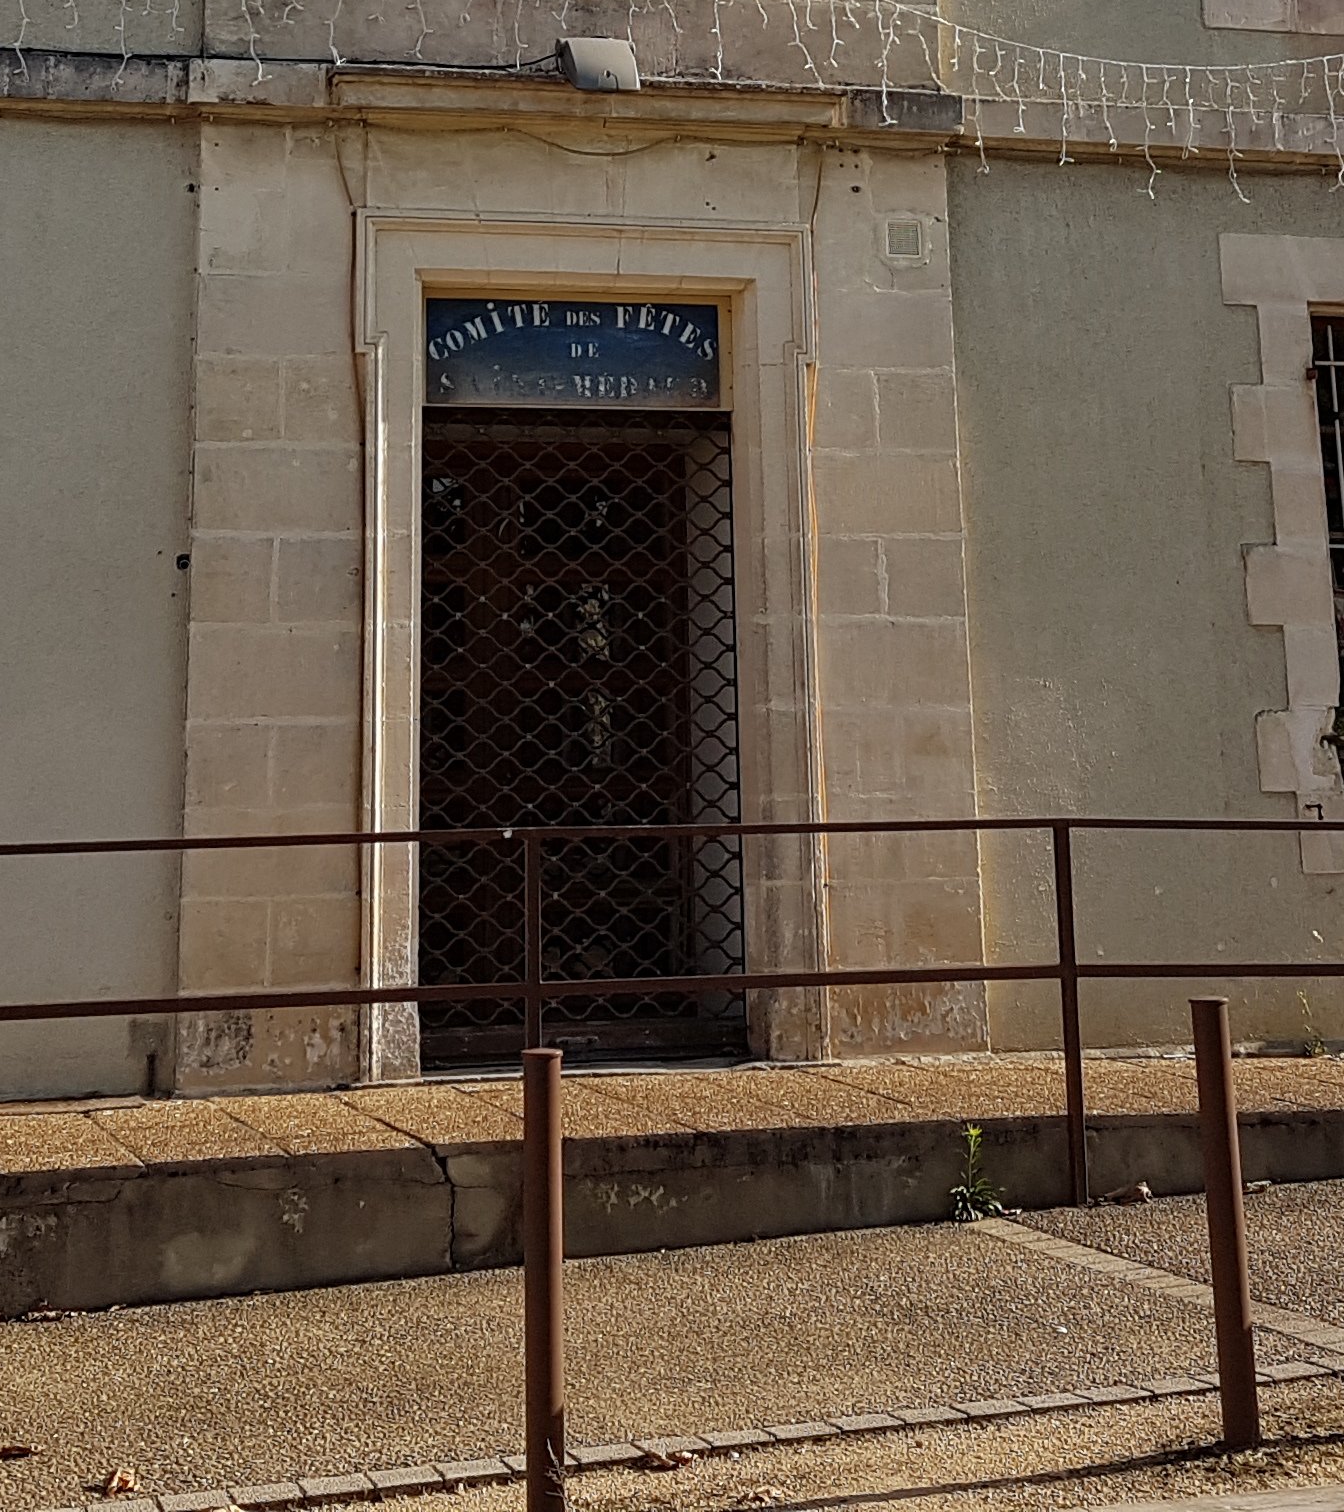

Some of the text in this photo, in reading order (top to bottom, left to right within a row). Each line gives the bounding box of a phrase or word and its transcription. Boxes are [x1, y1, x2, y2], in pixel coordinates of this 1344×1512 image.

[566, 311, 601, 326] DES
[615, 303, 717, 361] FÊTES
[570, 342, 599, 358] DE
